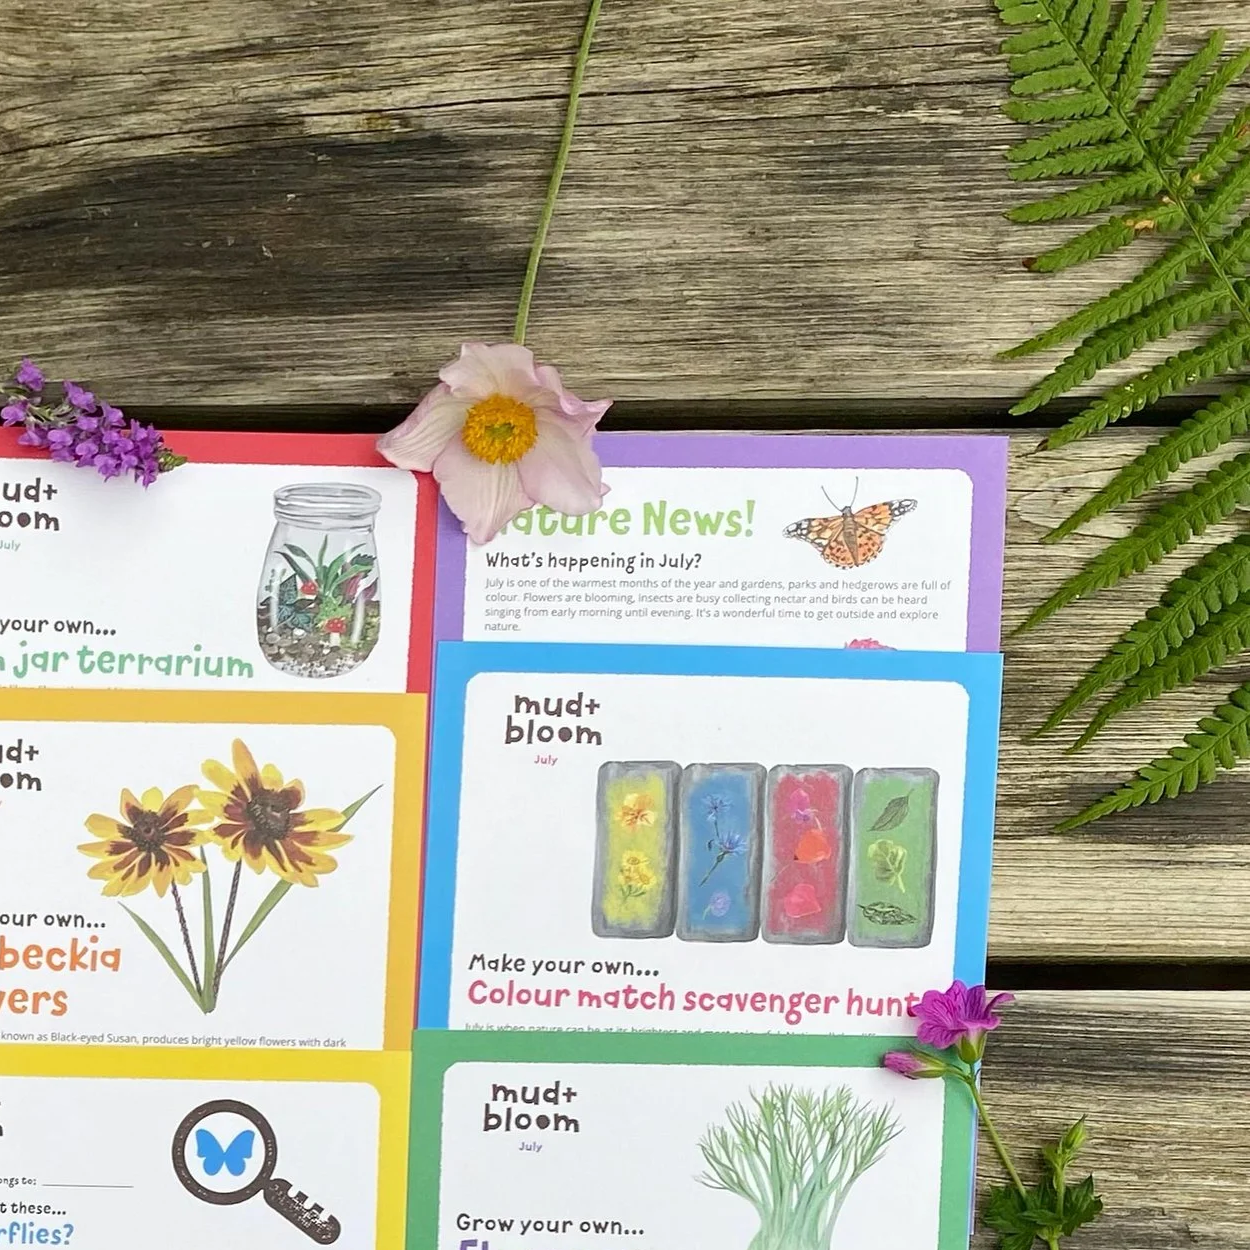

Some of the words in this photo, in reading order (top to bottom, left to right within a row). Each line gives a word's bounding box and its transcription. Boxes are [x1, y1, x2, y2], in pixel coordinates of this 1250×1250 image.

[501, 503, 632, 537] ature
[643, 500, 756, 537] News!
[485, 551, 543, 568] What's
[548, 552, 636, 573] happening
[640, 551, 654, 568] in
[658, 553, 702, 570] July?
[0, 619, 49, 635] your
[53, 620, 116, 636] own...
[12, 640, 69, 678] jar
[76, 645, 254, 677] terrarium
[510, 692, 600, 717] mud+
[504, 715, 602, 745] bloom
[533, 754, 558, 766] July
[43, 914, 106, 928] own...
[468, 953, 526, 972] Make
[531, 960, 585, 976] your
[591, 961, 659, 976] own...
[467, 979, 571, 1007] Colour
[577, 983, 675, 1010] match
[682, 991, 840, 1024] scavenger
[846, 988, 923, 1021] hunt
[1, 1031, 34, 1041] known
[51, 1032, 104, 1044] Black-eyed
[107, 1034, 139, 1044] Susan,
[142, 1035, 189, 1046] produces
[192, 1035, 222, 1047] bright
[224, 1036, 256, 1047] yellow
[259, 1036, 296, 1046] flowers
[299, 1038, 321, 1047] with
[323, 1038, 347, 1047] dark
[488, 1080, 577, 1105] mud+
[482, 1103, 579, 1132] bloom
[518, 1141, 543, 1153] July
[21, 1176, 36, 1185] to:
[10, 1201, 66, 1215] these...
[456, 1213, 515, 1232] Grow
[520, 1220, 573, 1235] your
[579, 1220, 644, 1235] own...
